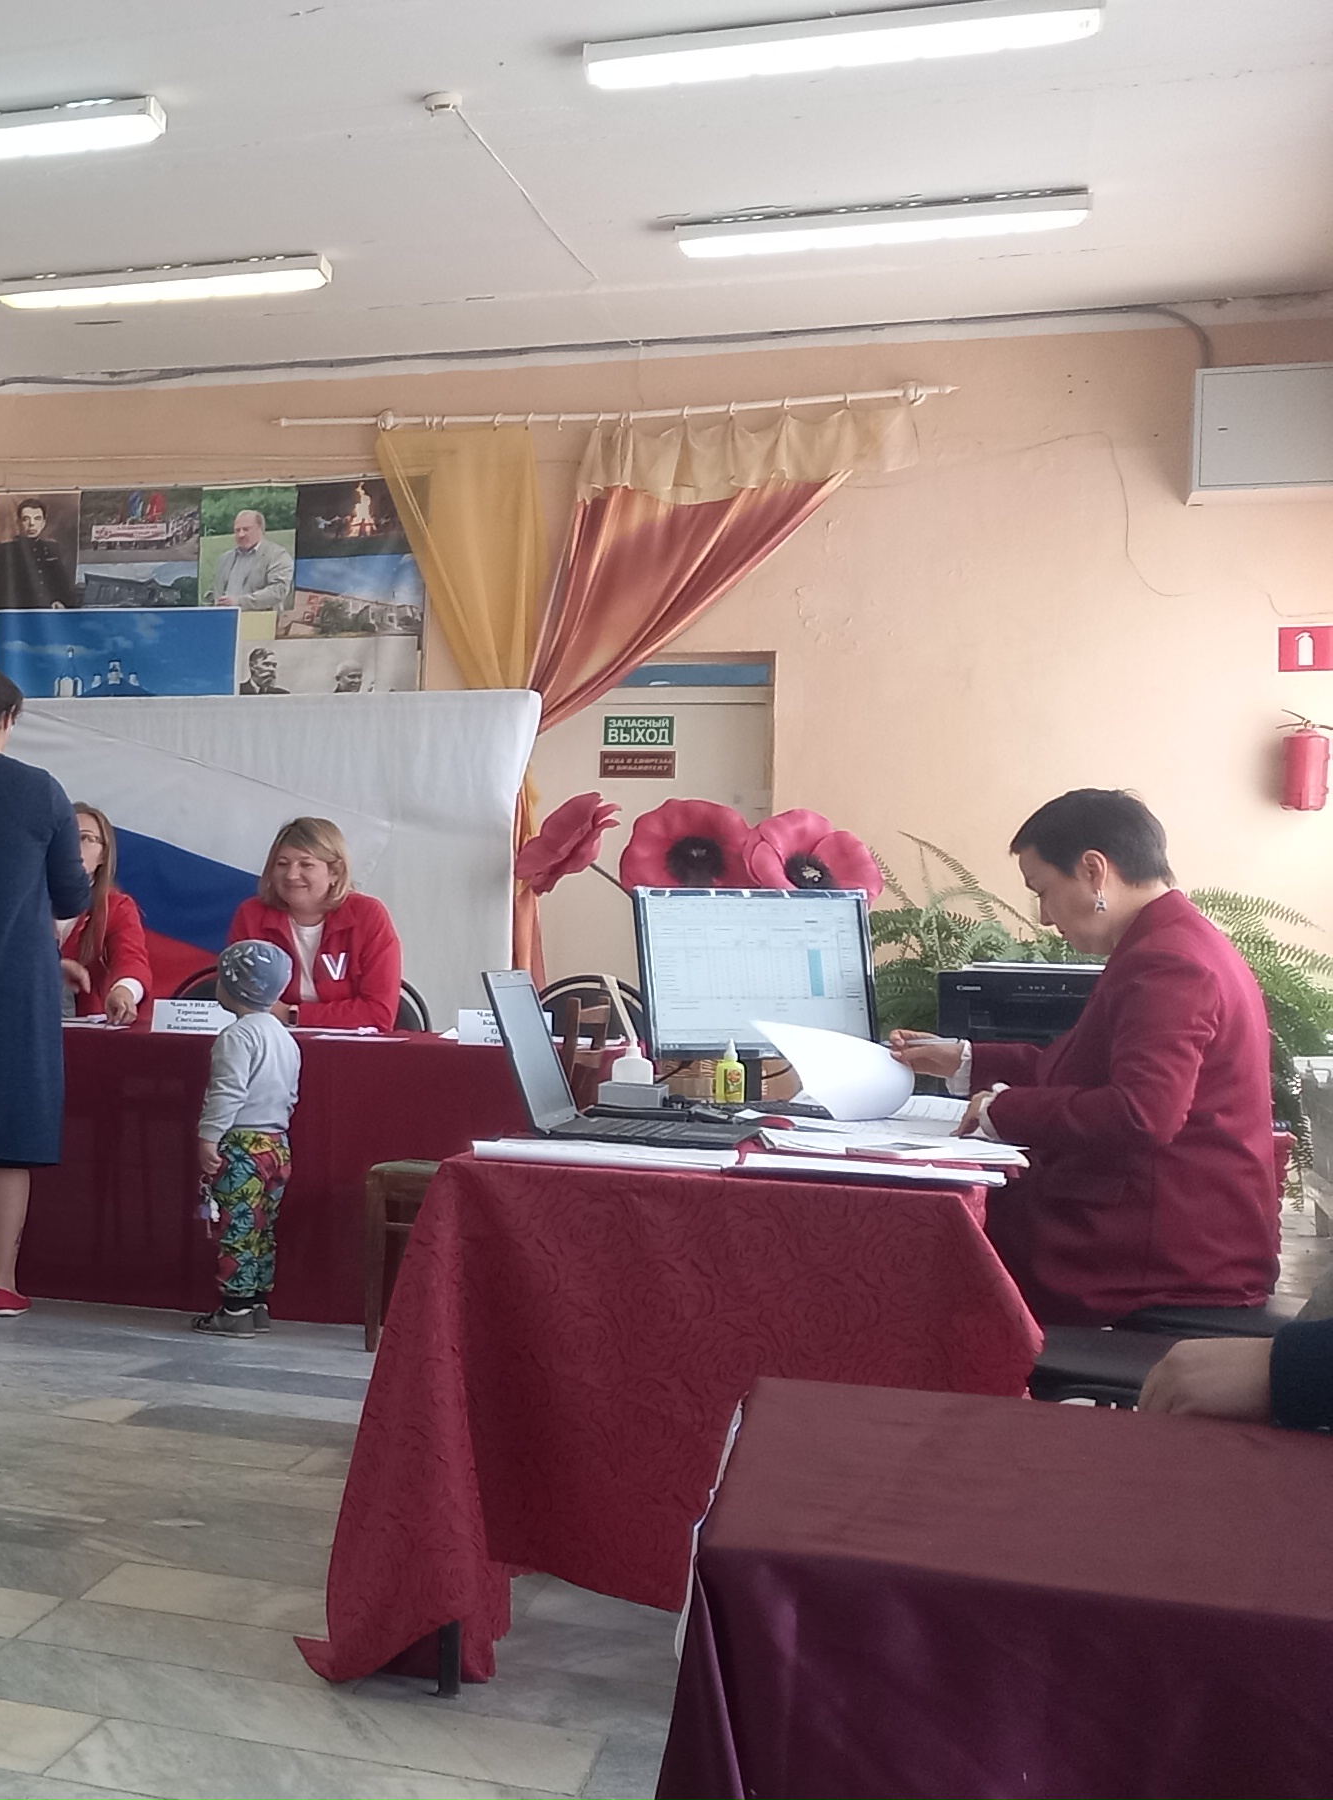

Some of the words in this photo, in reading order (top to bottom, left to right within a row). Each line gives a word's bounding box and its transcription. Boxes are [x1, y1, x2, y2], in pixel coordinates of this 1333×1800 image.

[608, 718, 670, 728] ЗАПАСНЫЙ
[607, 728, 670, 744] ВЫХОД
[321, 952, 349, 981] V
